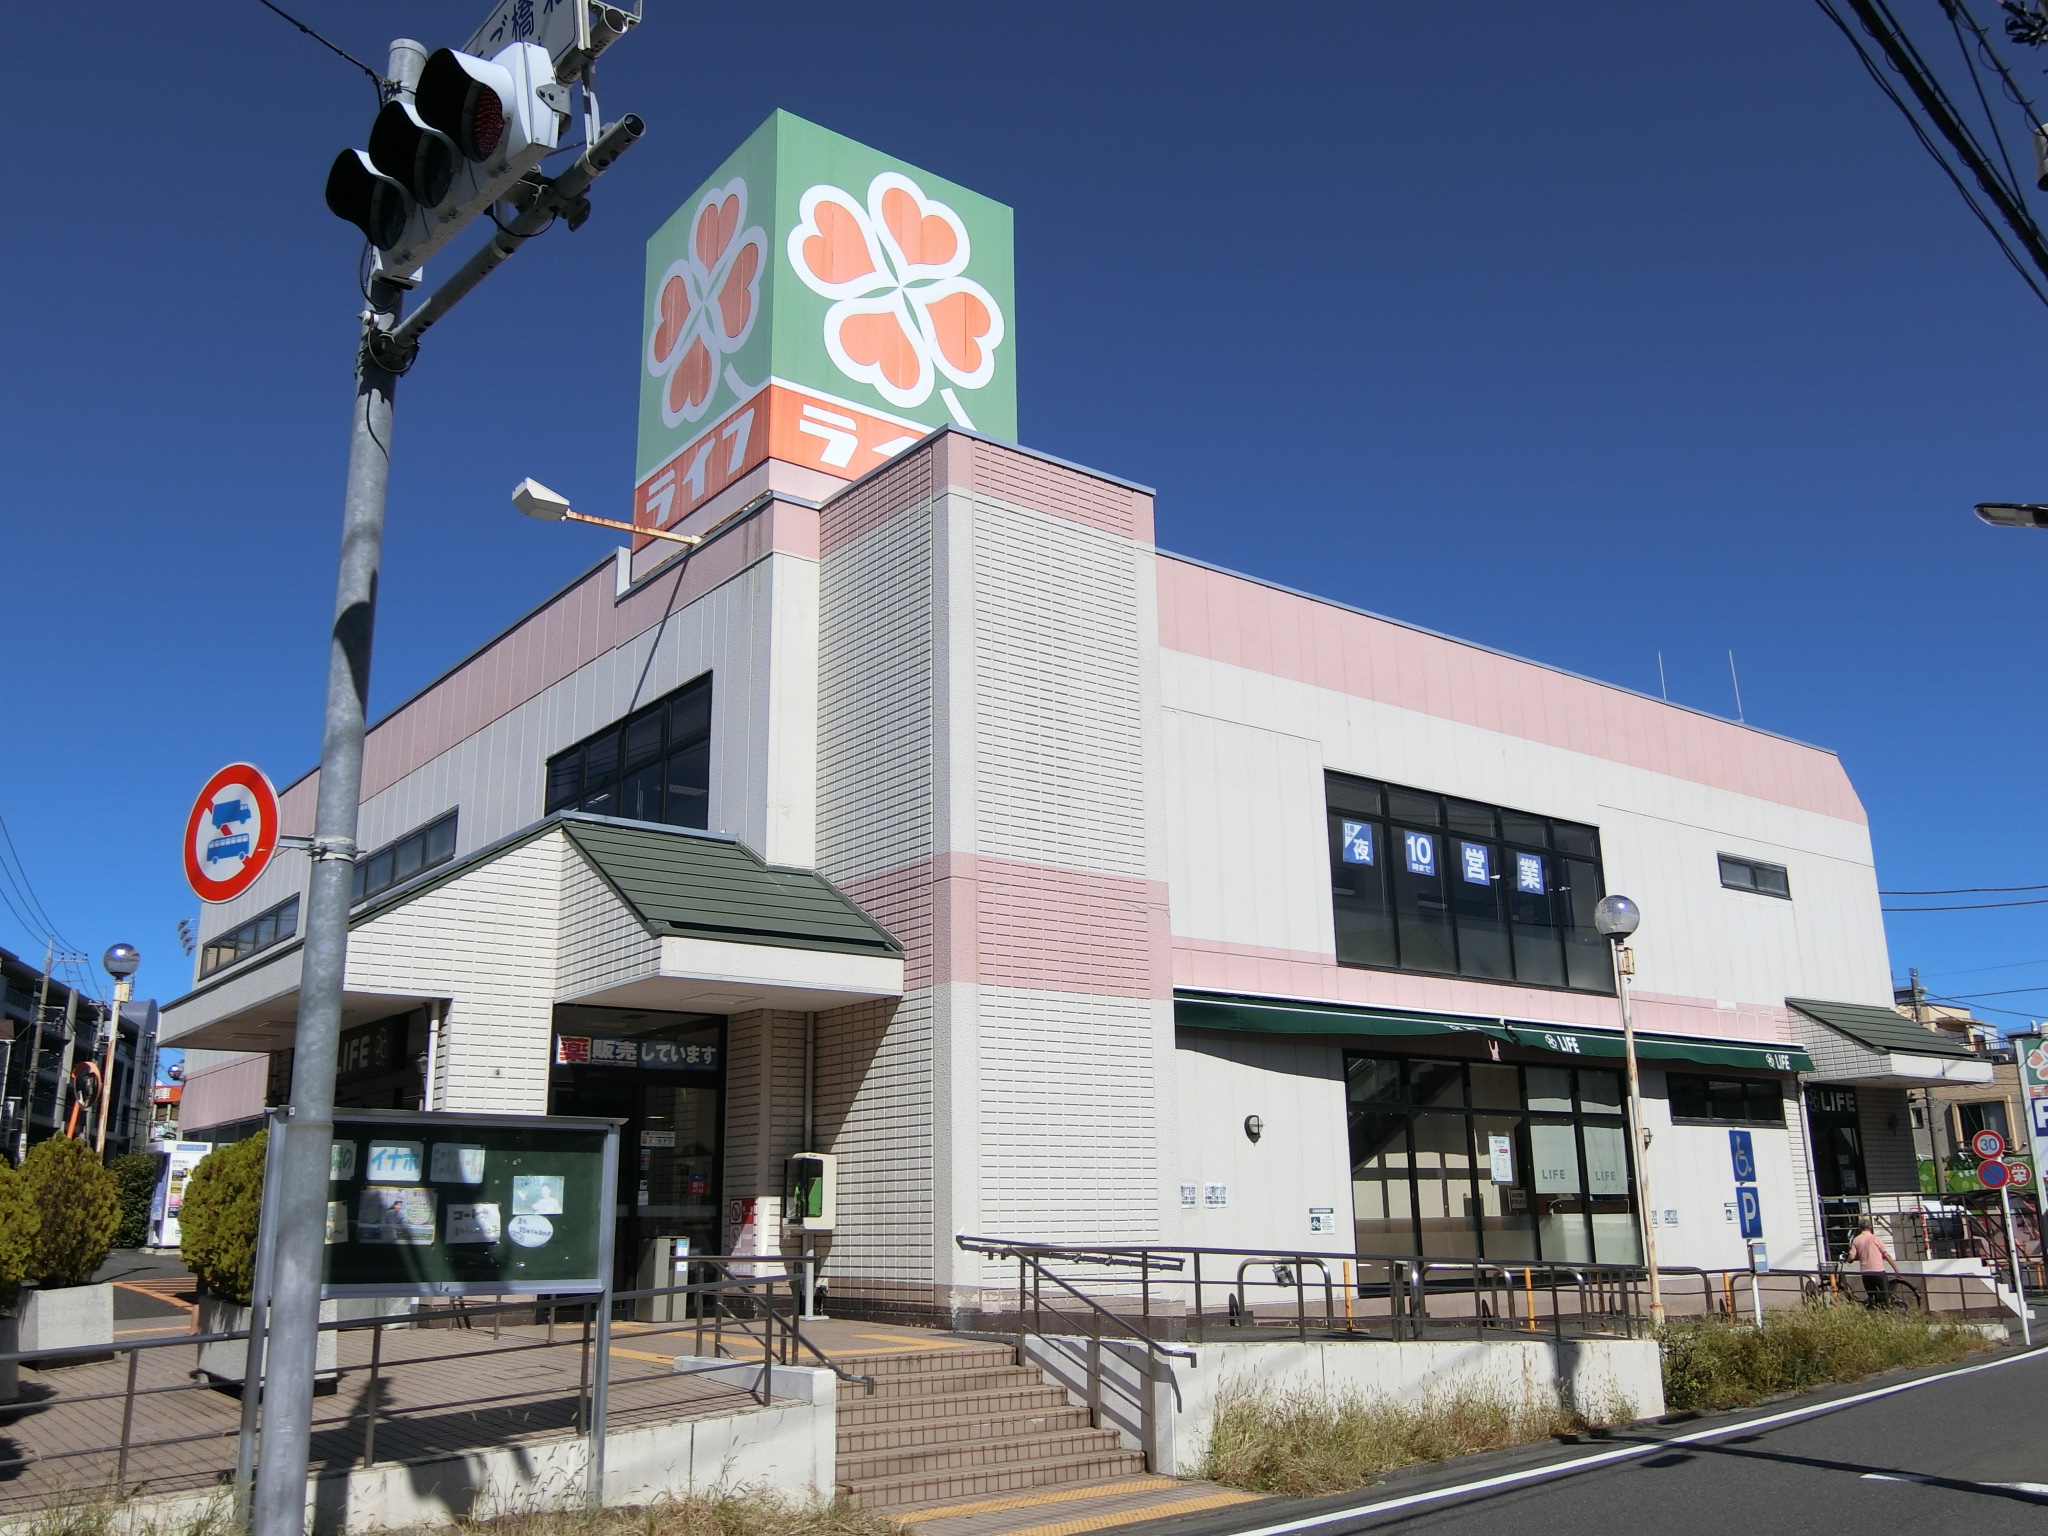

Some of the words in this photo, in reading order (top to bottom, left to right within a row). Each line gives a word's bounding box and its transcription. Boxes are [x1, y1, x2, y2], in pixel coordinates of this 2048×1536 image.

[646, 408, 755, 528] ライフ
[1353, 838, 1371, 862] 夜
[1406, 835, 1432, 864] 10
[1411, 862, 1432, 873] 時まで
[1557, 1036, 1580, 1054] LIFE
[337, 1035, 370, 1074] IFE
[1774, 1054, 1790, 1070] LIFE
[1820, 1091, 1856, 1112] LIFE
[1979, 1138, 1998, 1151] 30
[370, 1148, 420, 1172] イナホ
[1542, 1169, 1566, 1180] LIFE
[1595, 1171, 1616, 1181] LIFE
[2007, 1166, 2028, 1183] 栄
[1742, 1191, 1757, 1234] P
